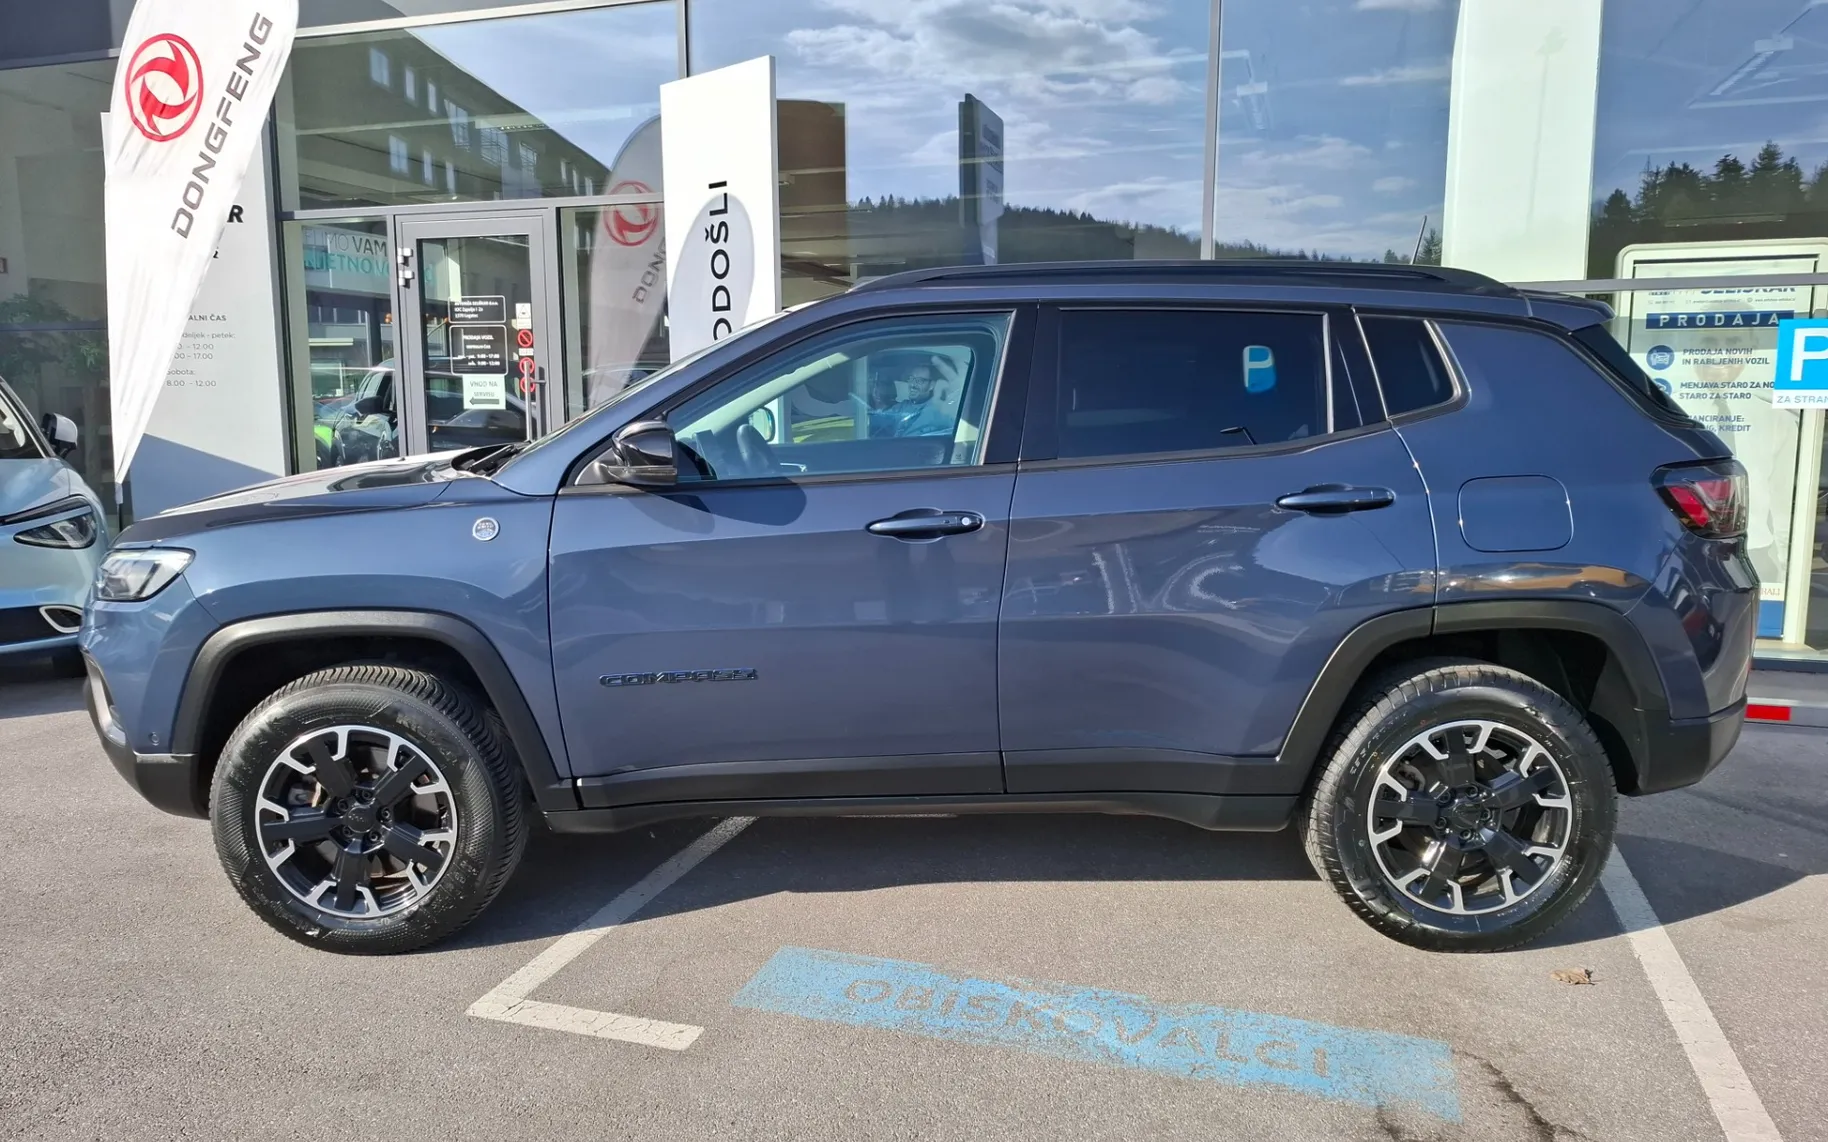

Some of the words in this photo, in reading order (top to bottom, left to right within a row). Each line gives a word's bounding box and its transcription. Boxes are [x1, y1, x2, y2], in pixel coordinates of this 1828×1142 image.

[171, 12, 273, 239] DONGFENG
[352, 236, 387, 257] VAM
[209, 313, 227, 321] ČAS
[1659, 313, 1779, 327] PRODAJA
[1745, 357, 1770, 365] VOZIL
[1680, 392, 1707, 400] STARO
[1709, 392, 1721, 400] ZA
[1723, 392, 1752, 400] STARO
[1777, 395, 1791, 404] ZA
[1719, 424, 1751, 432] KREDIT
[599, 668, 758, 687] COMPASS
[844, 979, 1329, 1078] OBISKOVALCI
